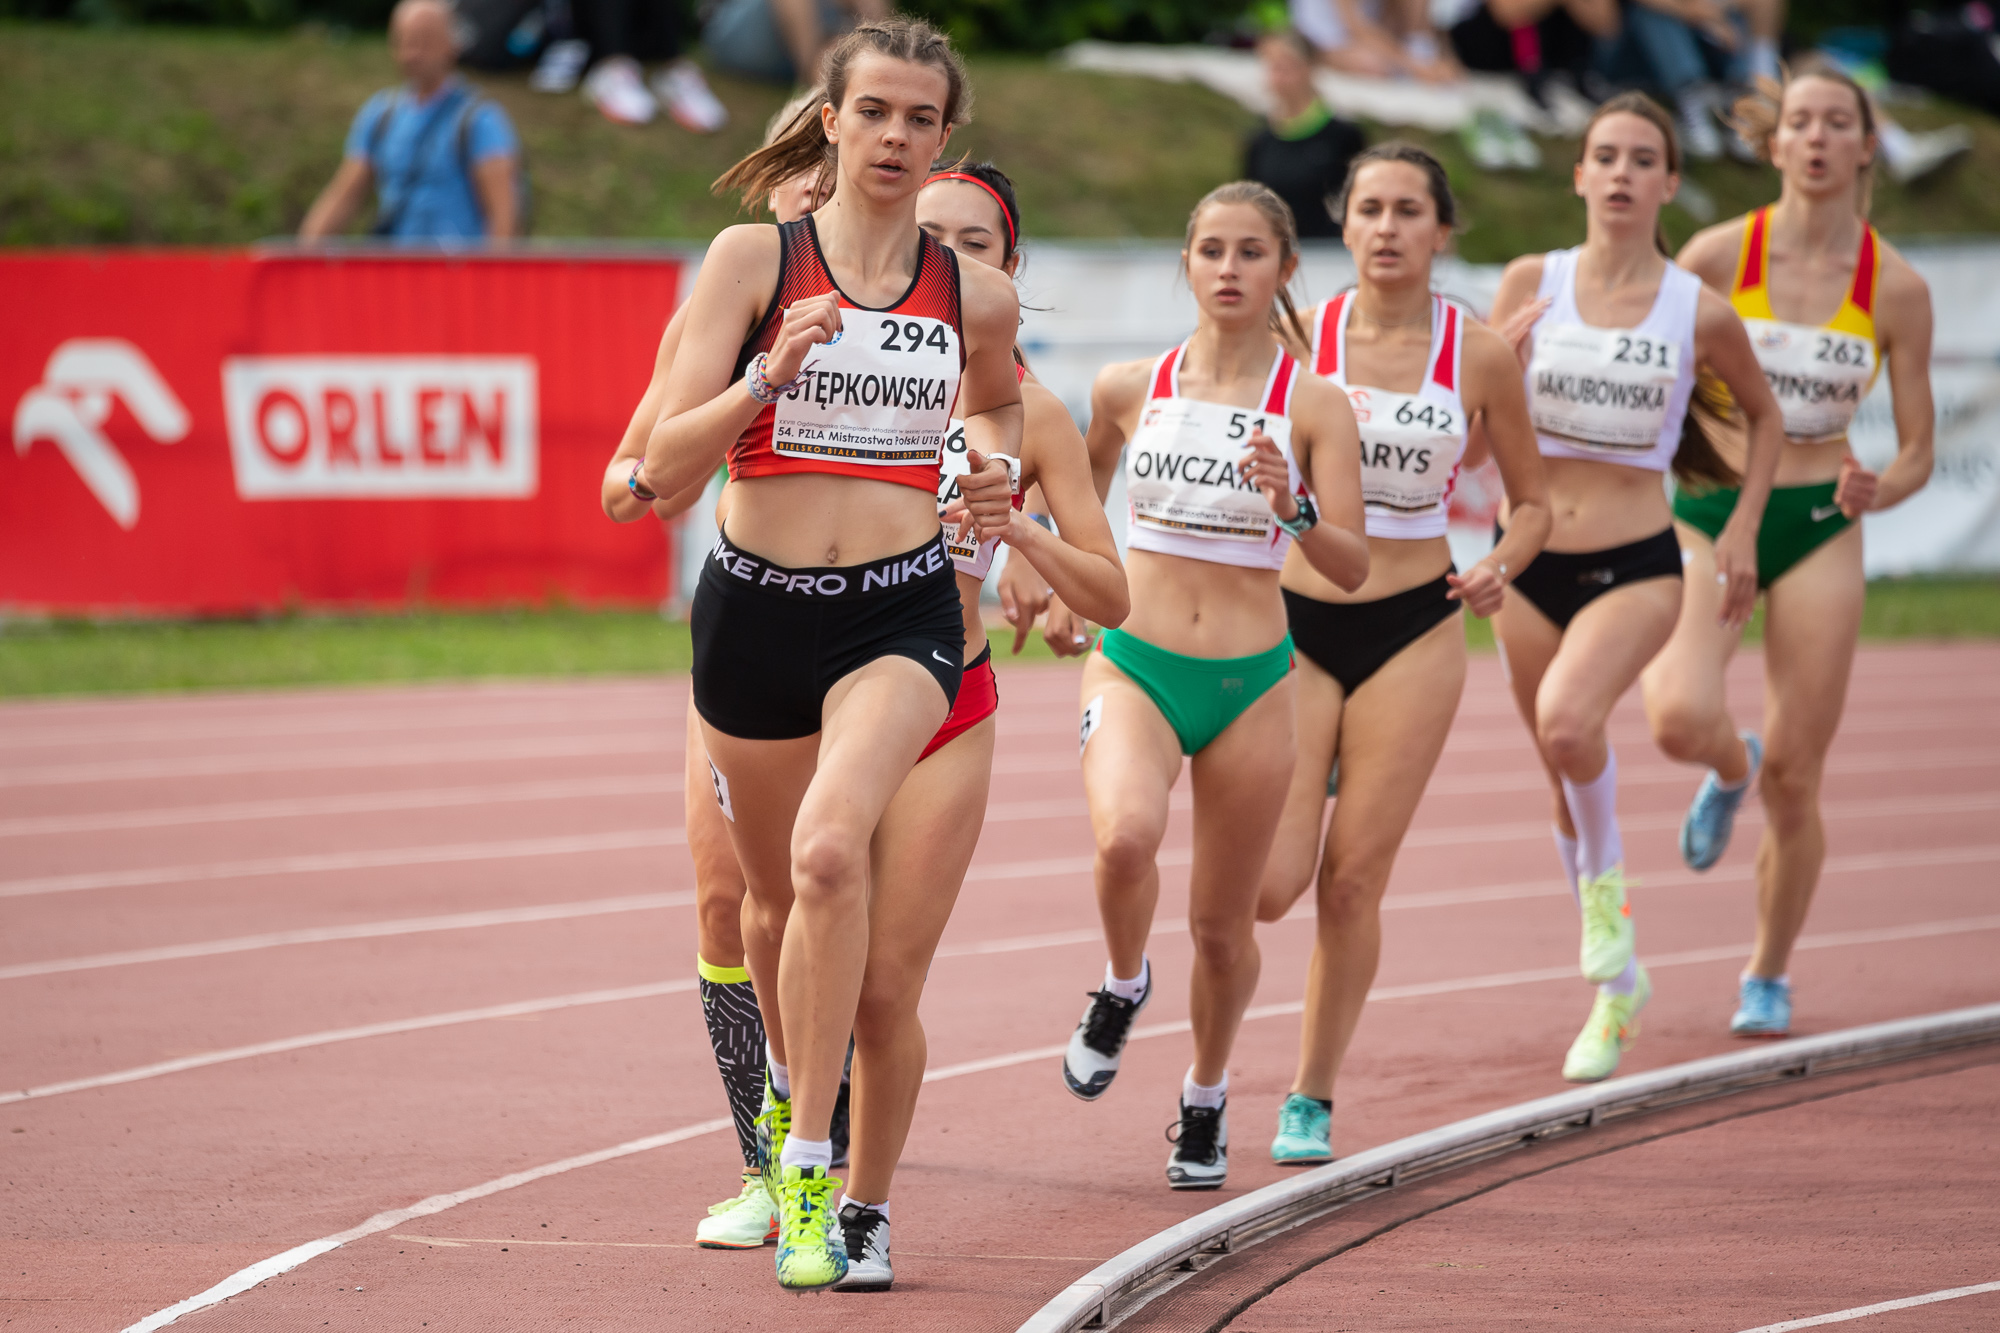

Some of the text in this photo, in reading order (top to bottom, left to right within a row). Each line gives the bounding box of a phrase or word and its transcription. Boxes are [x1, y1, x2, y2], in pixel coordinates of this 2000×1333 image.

[880, 319, 948, 354] 294
[1614, 336, 1669, 368] 231
[1815, 335, 1866, 367] 262
[1536, 370, 1665, 412] JAKUBOWSKA
[256, 388, 503, 470] ORLEN
[796, 420, 839, 430] Ogólnopolska
[839, 424, 871, 432] Olimpiada
[1396, 401, 1453, 434] 642
[777, 426, 940, 446] 54. PZLA Mistrzostwa Polski U18
[779, 442, 935, 459] BIELSKO-BIAŁA 15-17.07.2022
[1134, 451, 1263, 494] OWCZA
[712, 532, 760, 581] IKE
[759, 567, 847, 596] PRO
[861, 546, 945, 592] NIKE
